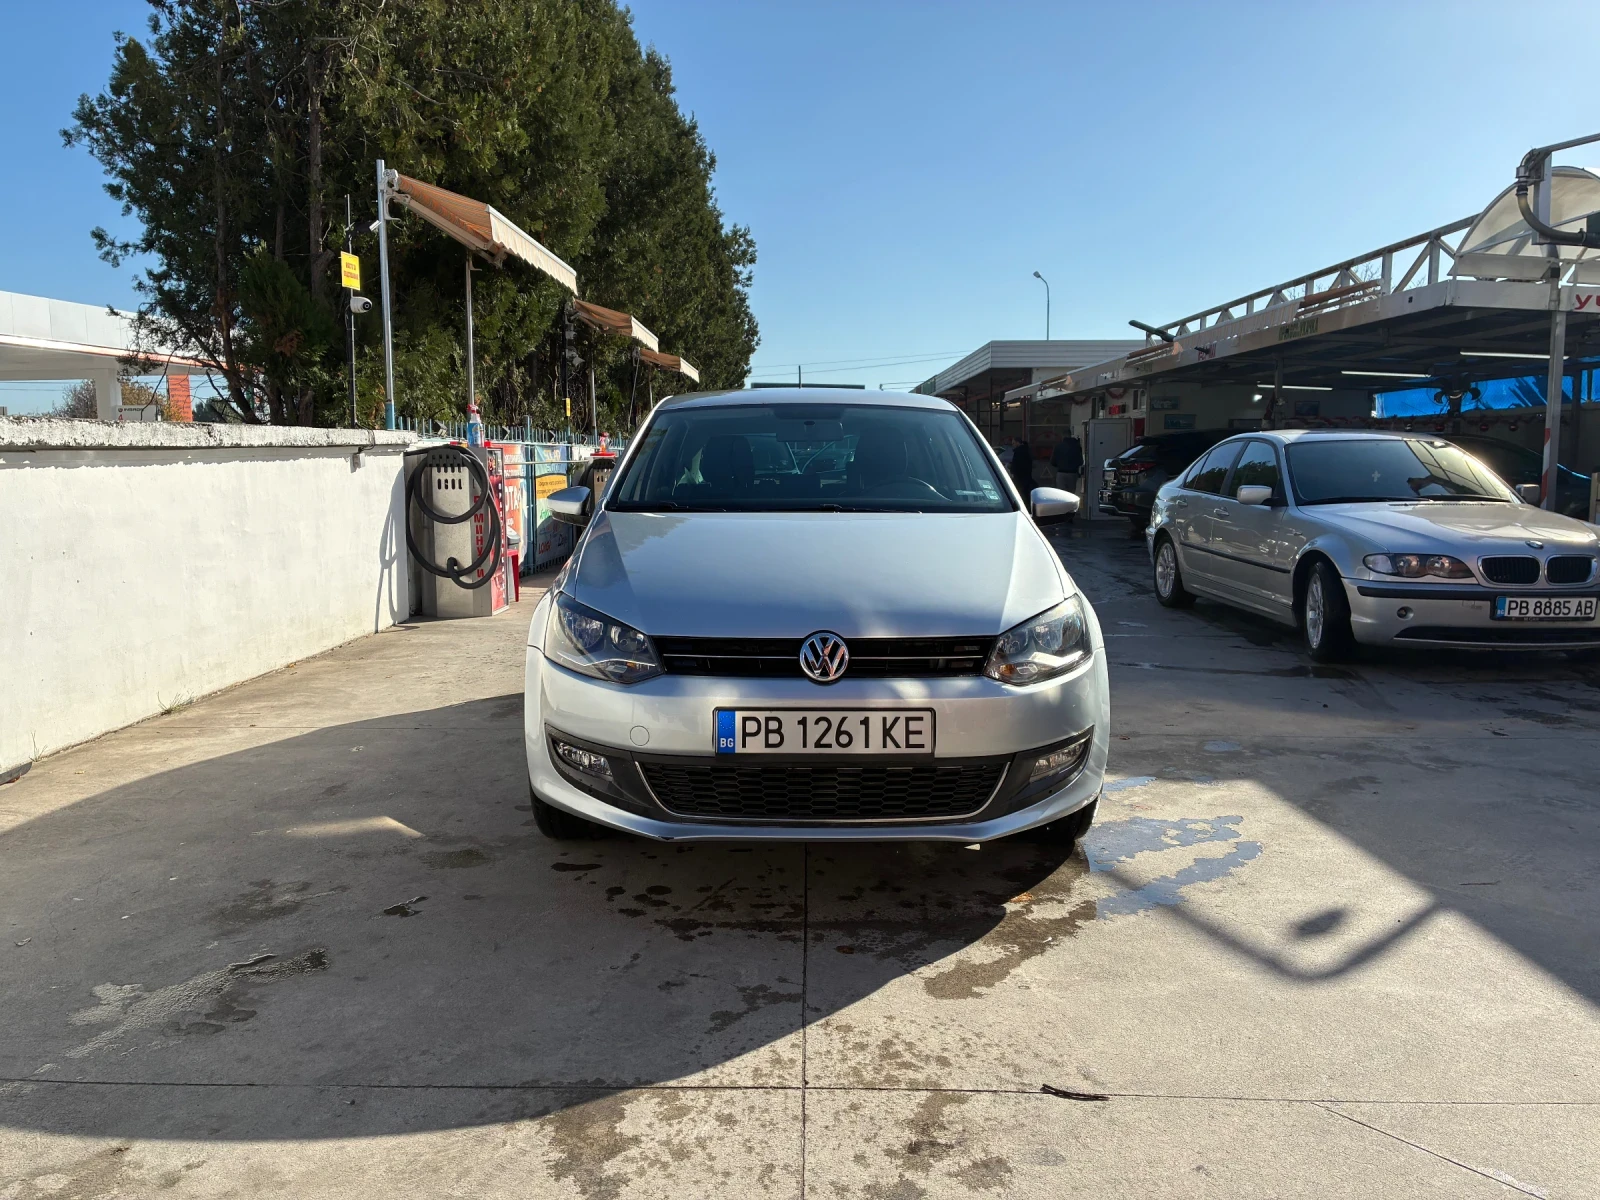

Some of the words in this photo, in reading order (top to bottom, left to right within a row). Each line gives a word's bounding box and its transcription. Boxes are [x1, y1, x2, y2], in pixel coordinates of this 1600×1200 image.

[473, 513, 486, 578] МИНУИ
[1507, 600, 1530, 616] PB
[1533, 600, 1571, 616] 8885
[1574, 600, 1593, 616] AB
[719, 737, 734, 748] BG
[741, 716, 785, 749] PB
[796, 716, 870, 749] 1261
[882, 716, 925, 749] KE
